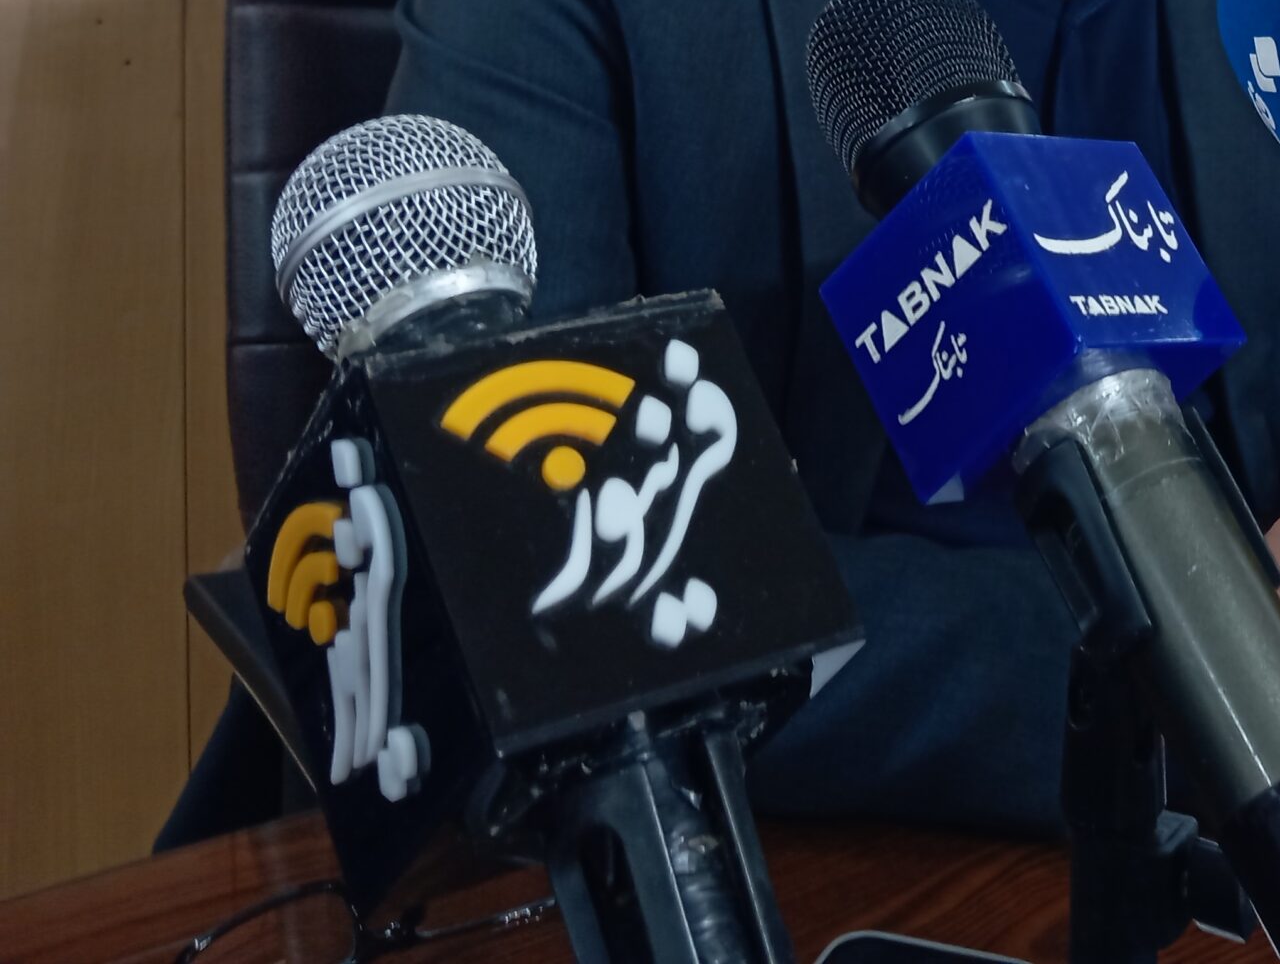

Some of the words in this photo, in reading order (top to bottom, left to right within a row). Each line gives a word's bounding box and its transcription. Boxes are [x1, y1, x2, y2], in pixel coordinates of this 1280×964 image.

[1033, 170, 1180, 263] تابناک
[855, 198, 1008, 364] TABNAK
[1070, 294, 1169, 316] TABNAK
[897, 320, 968, 426] تابناک
